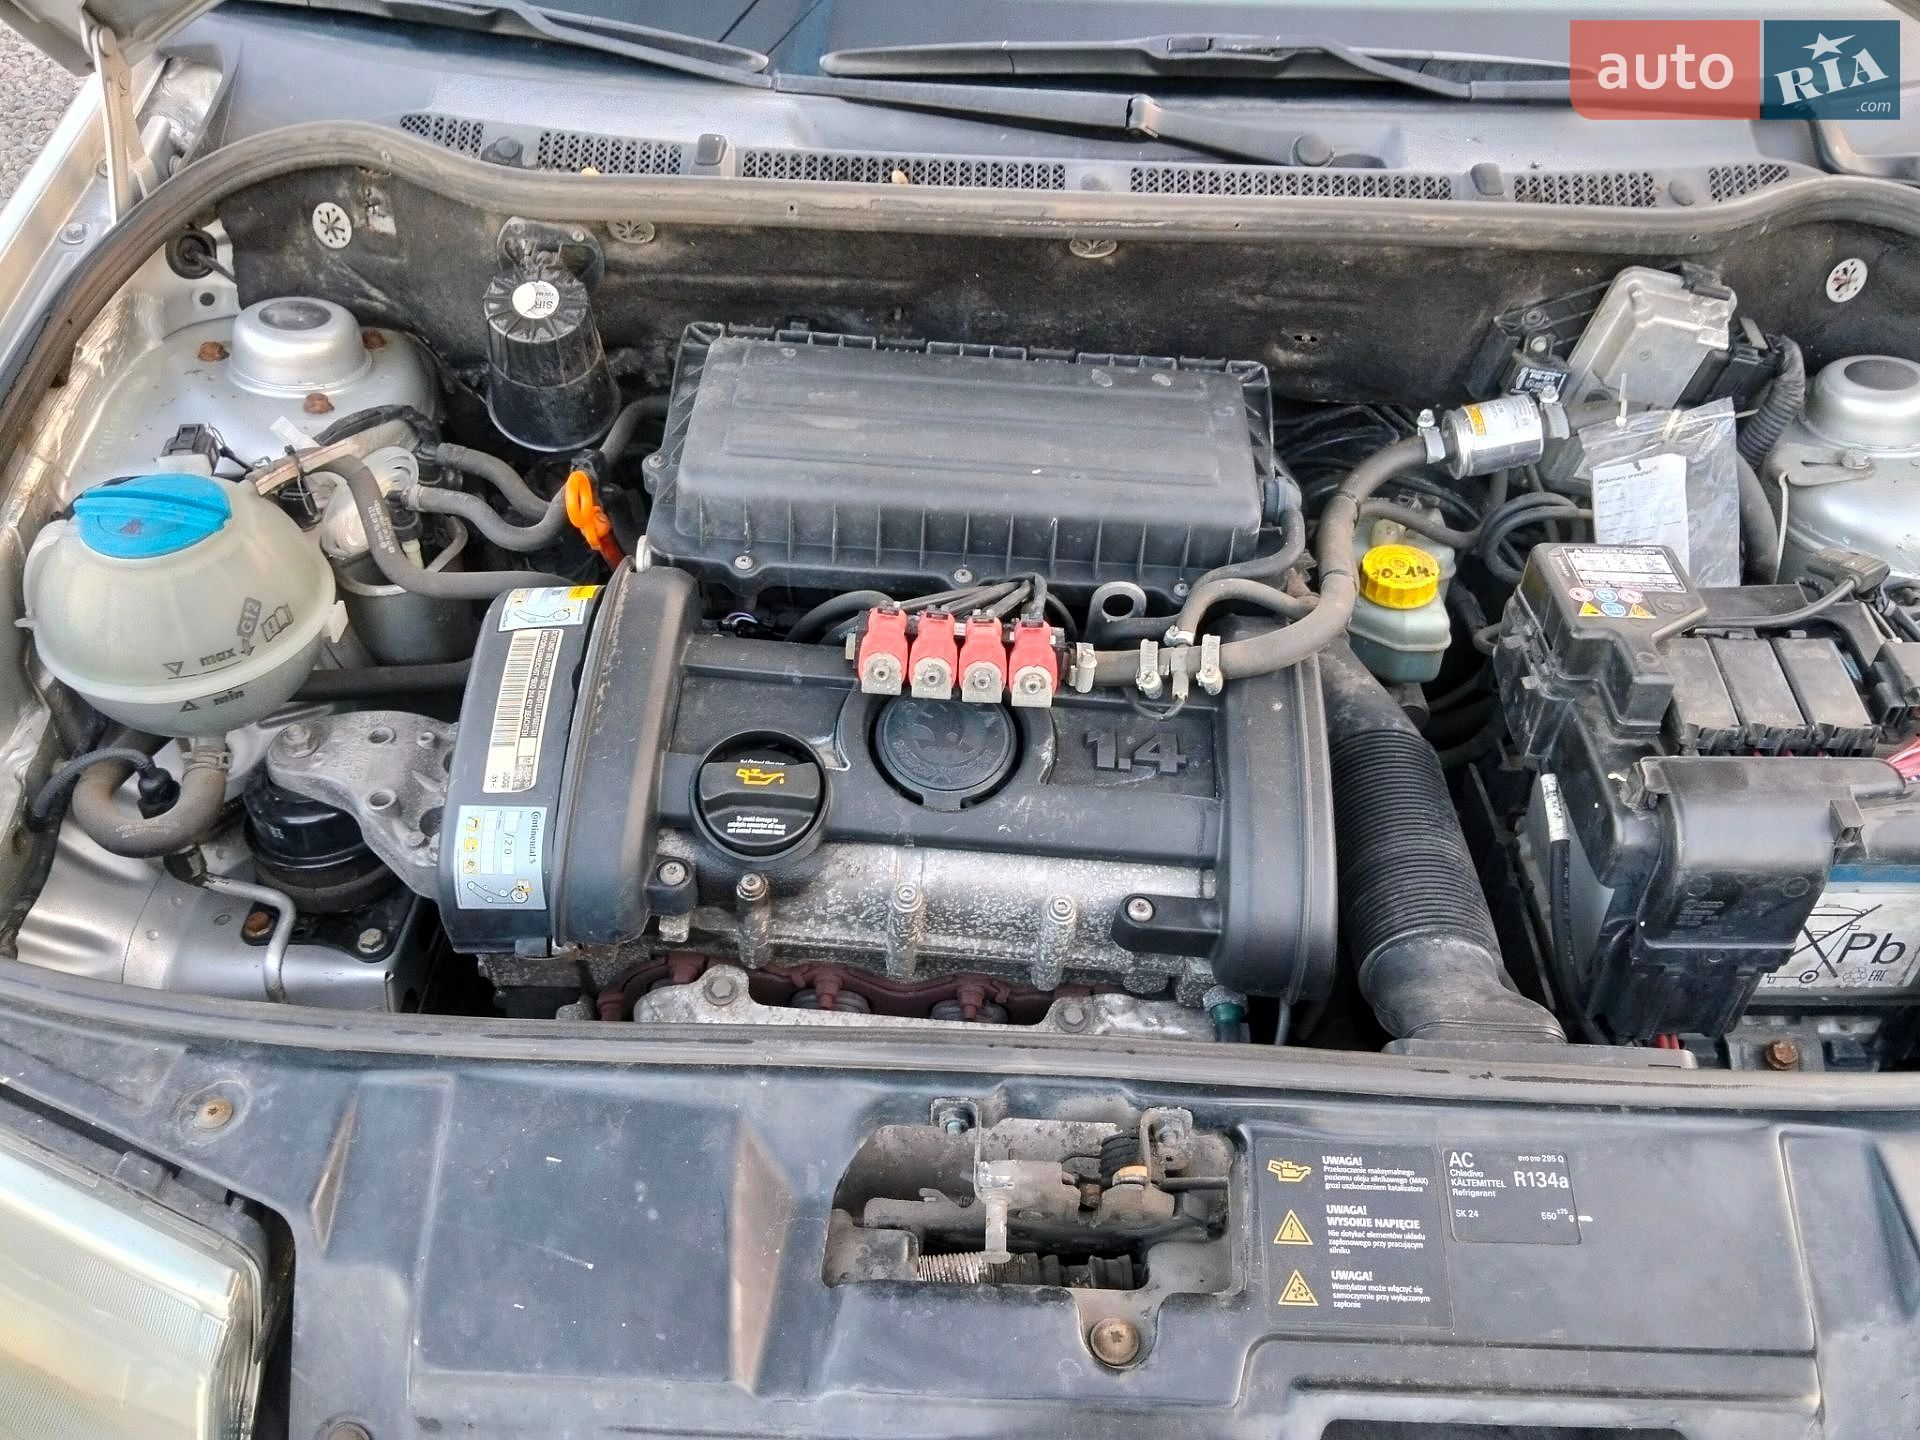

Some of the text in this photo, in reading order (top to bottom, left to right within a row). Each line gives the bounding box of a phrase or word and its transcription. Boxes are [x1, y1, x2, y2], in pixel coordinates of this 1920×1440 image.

[240, 602, 260, 633] G12
[200, 648, 237, 667] max
[213, 690, 245, 705] min
[1084, 729, 1188, 775] 1.4
[529, 811, 542, 857] Continental
[1836, 933, 1906, 965] Pb
[1322, 1155, 1362, 1165] UWAGA!
[1449, 1151, 1474, 1168] AC
[1513, 1170, 1569, 1189] R134a
[1452, 1188, 1496, 1198] Refrigerant
[1326, 1204, 1367, 1215] UWAGA!
[1455, 1209, 1479, 1218] SK 24
[1541, 1211, 1557, 1220] 550
[1326, 1216, 1420, 1230] WYSOKIE NAPIĘCIE
[1331, 1270, 1373, 1281] UWAGA!
